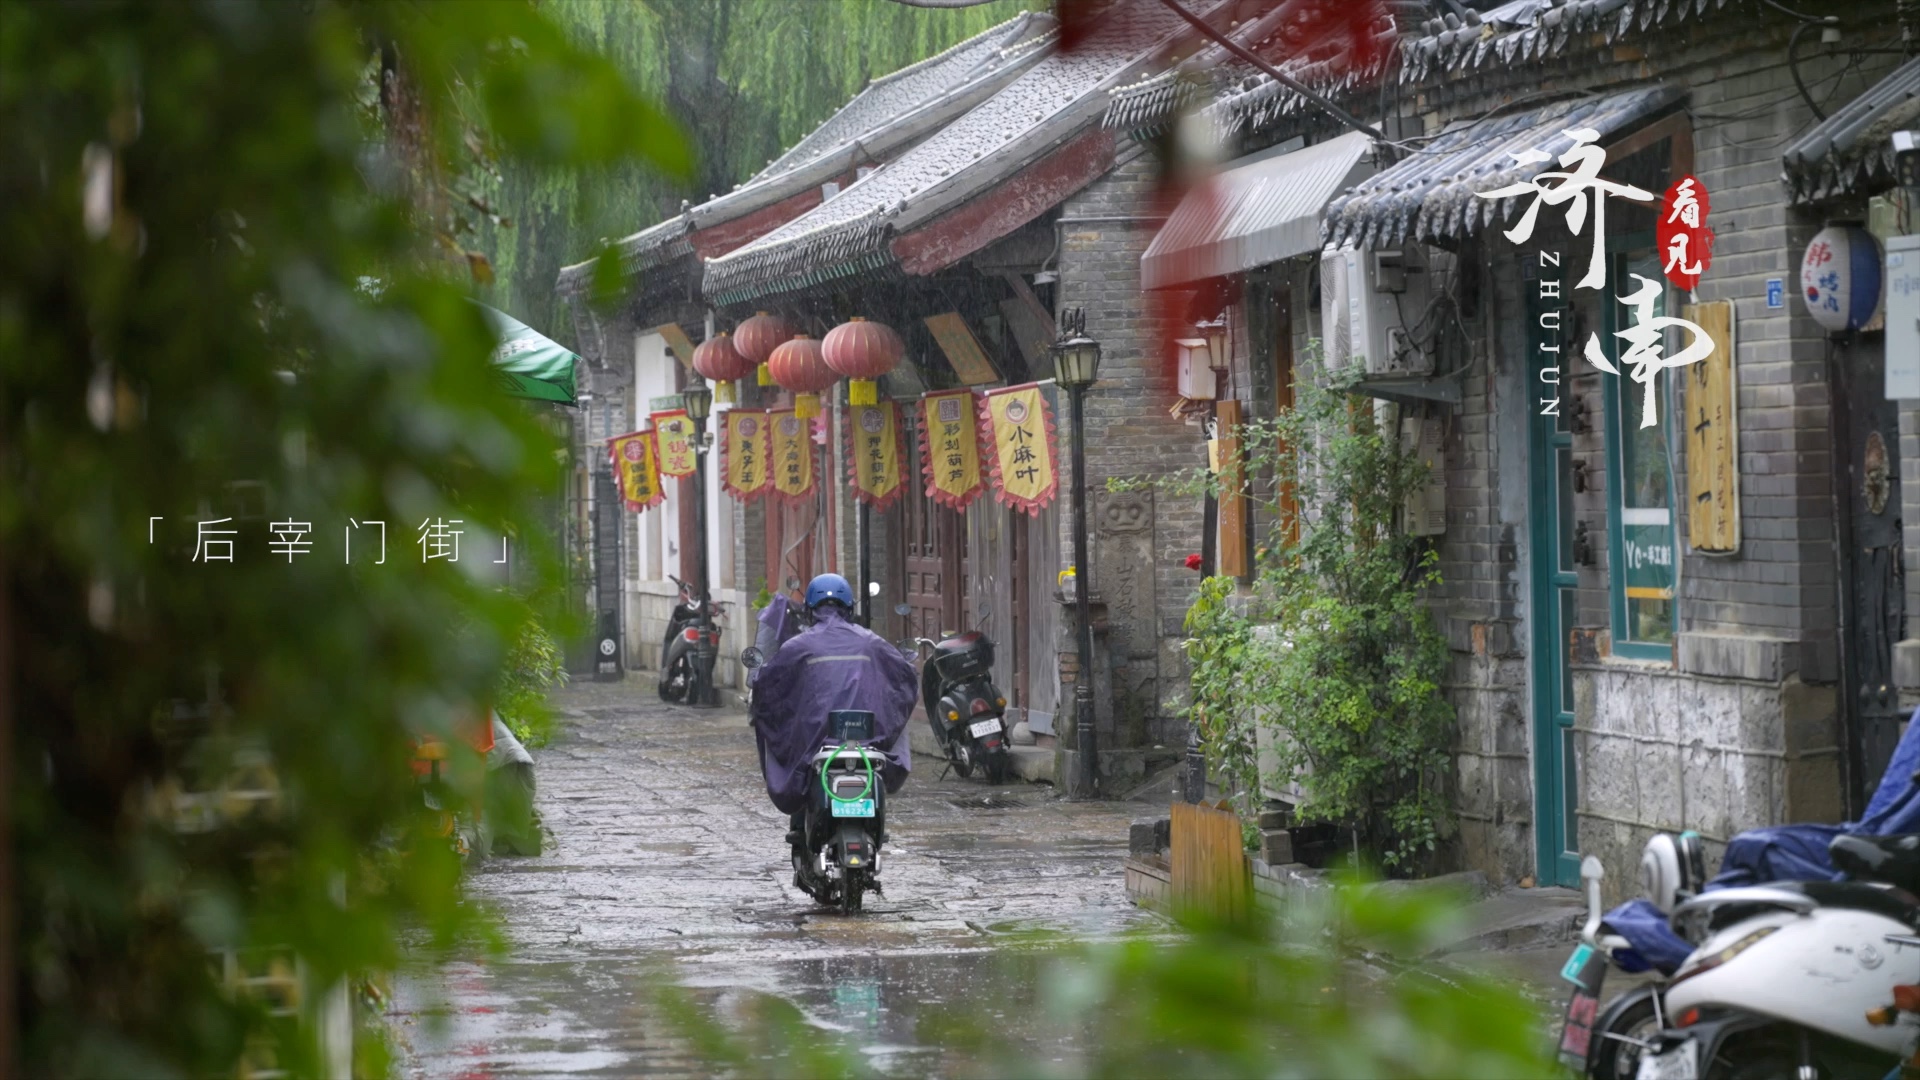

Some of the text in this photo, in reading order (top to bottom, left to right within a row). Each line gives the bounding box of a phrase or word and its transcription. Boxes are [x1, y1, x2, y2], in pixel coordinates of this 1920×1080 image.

[1819, 271, 1840, 313] 烤肉
[943, 423, 964, 482] 彩刻葫芦
[1009, 425, 1040, 485] 小麻叶
